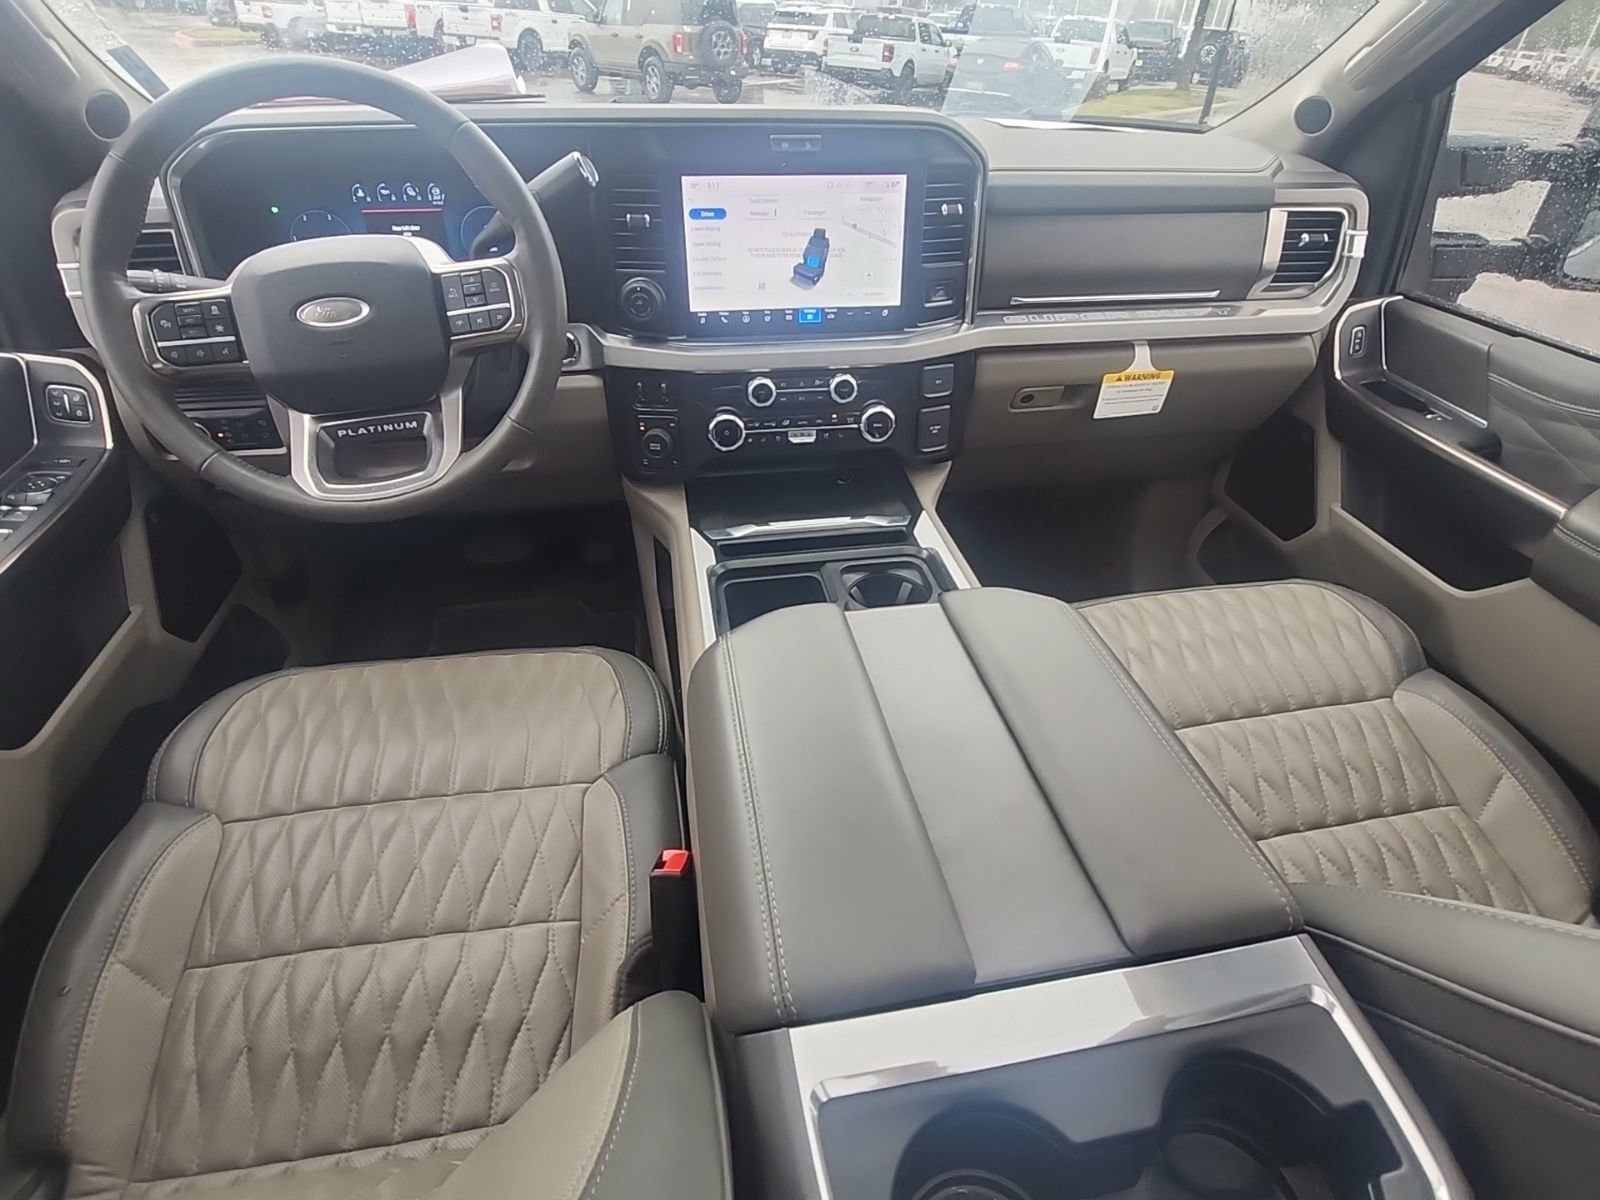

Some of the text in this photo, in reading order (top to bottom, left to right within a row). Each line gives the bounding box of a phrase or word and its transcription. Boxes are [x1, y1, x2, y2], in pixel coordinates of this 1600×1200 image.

[1003, 311, 1131, 323] SUPER
[1124, 372, 1161, 381] WARNING
[337, 420, 418, 437] PLATINUM
